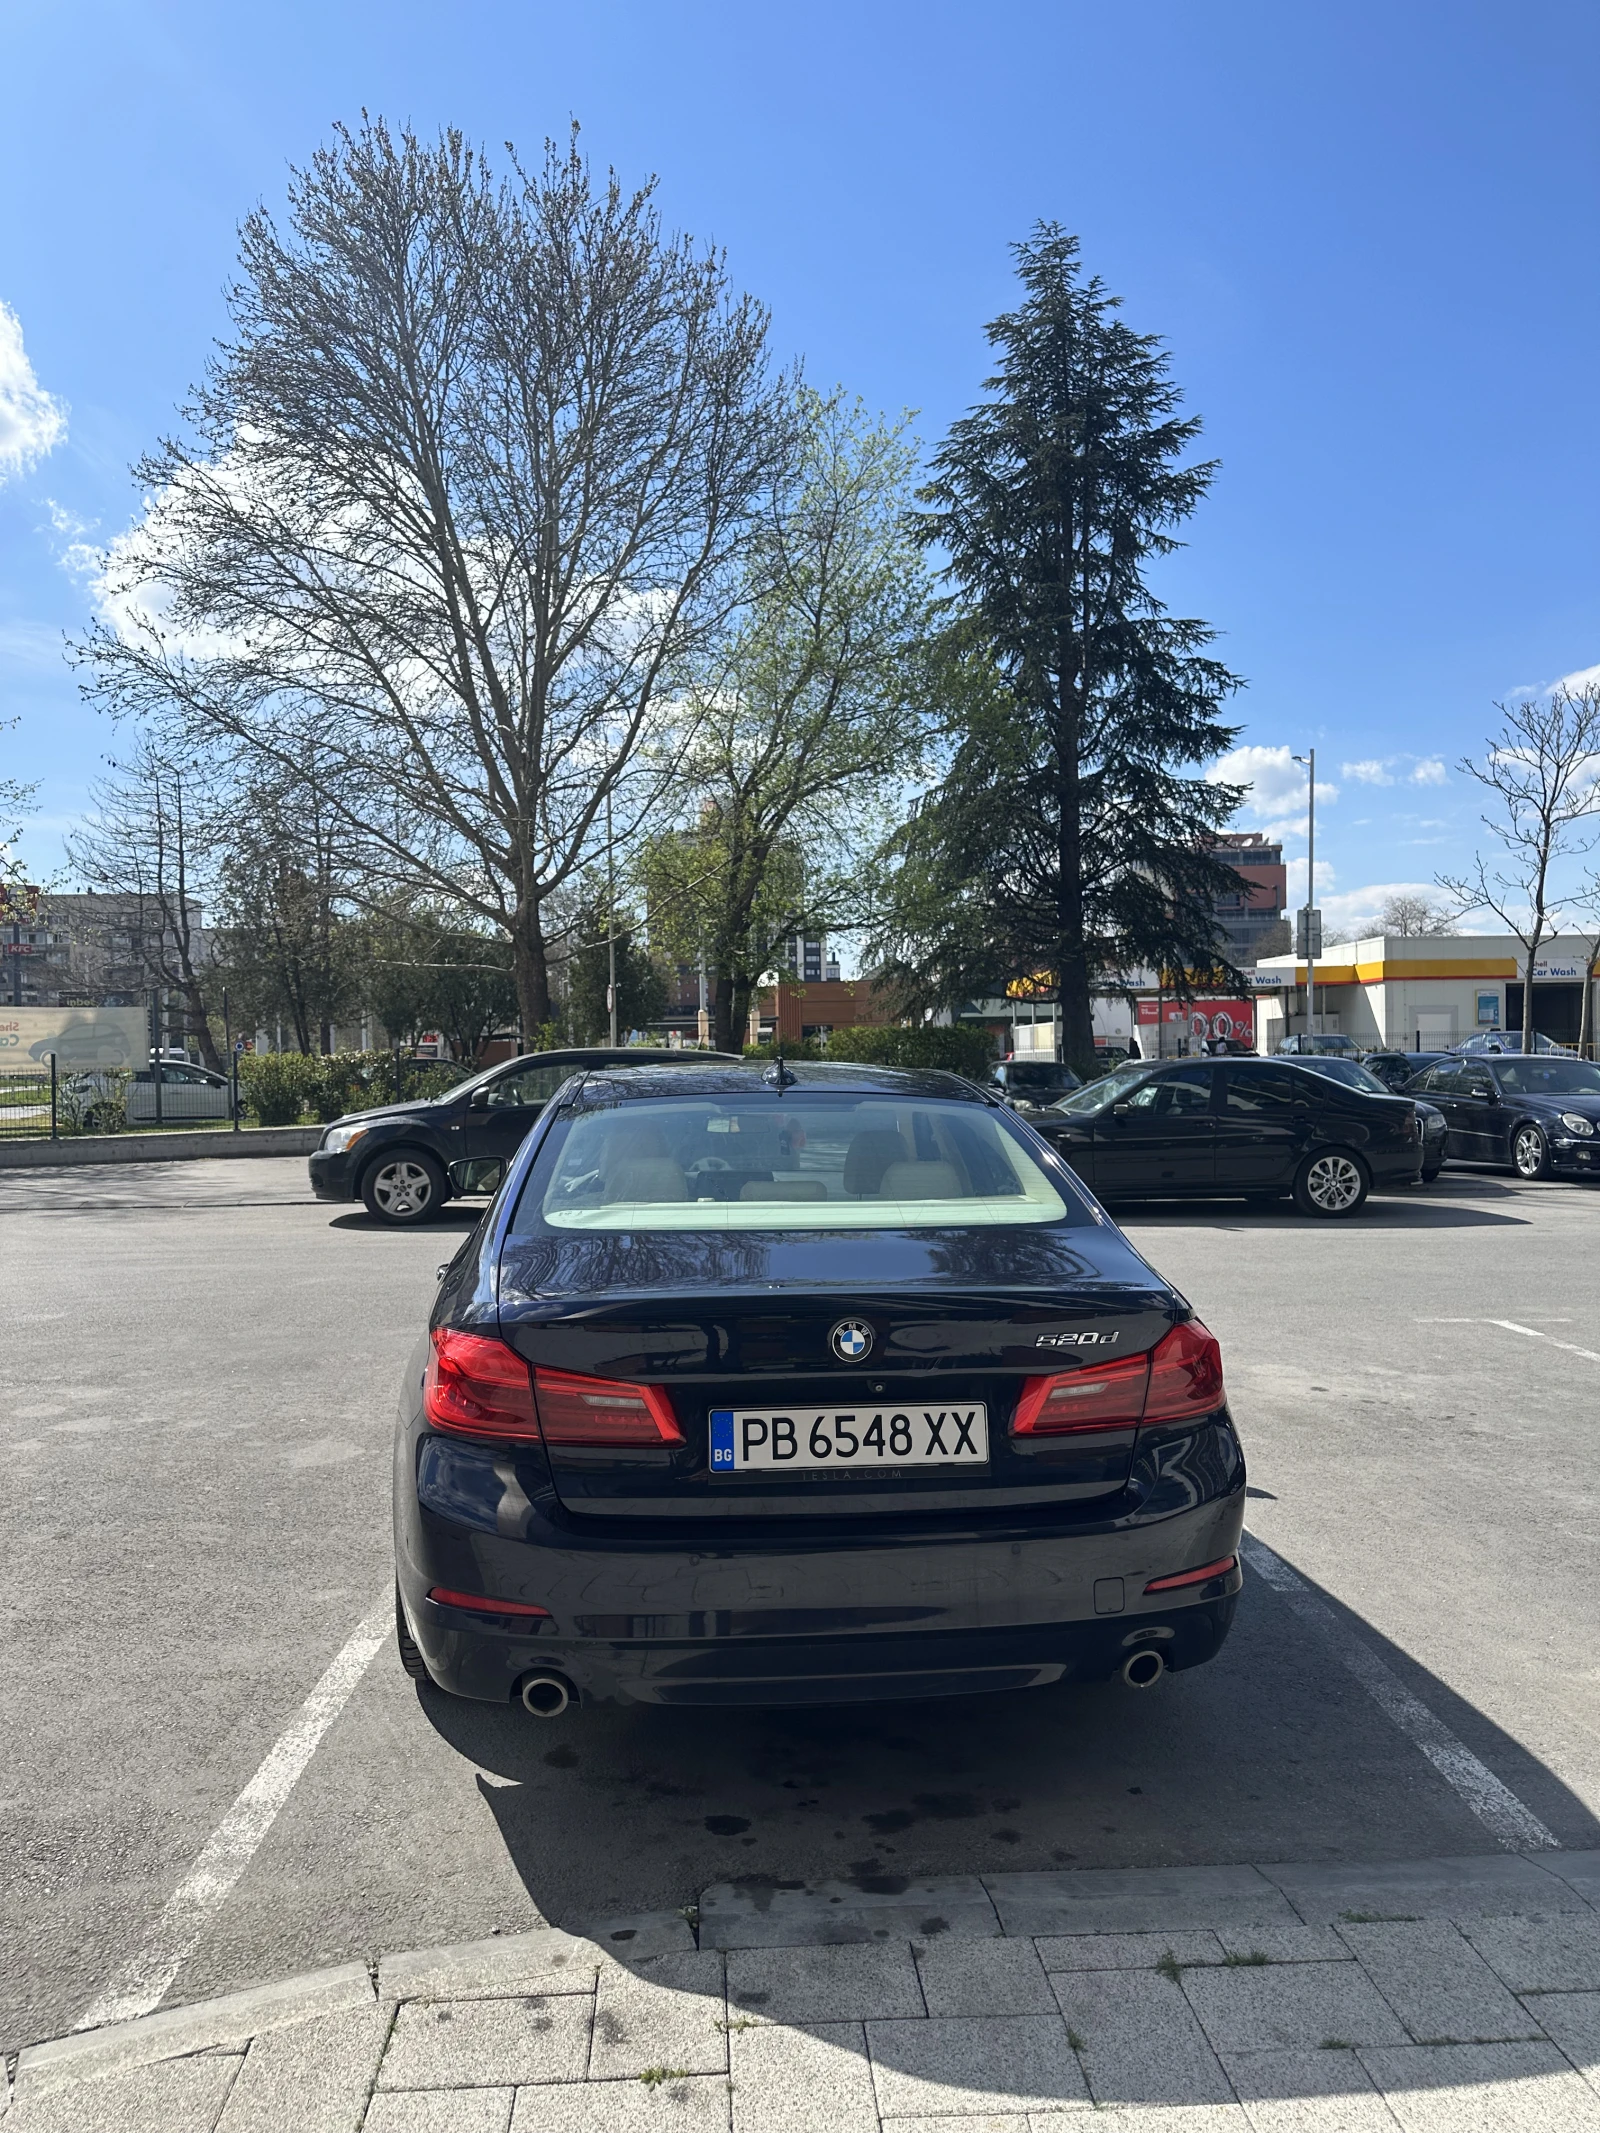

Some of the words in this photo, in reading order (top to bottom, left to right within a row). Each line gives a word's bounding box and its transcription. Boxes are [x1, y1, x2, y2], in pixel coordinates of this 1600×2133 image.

[10, 945, 31, 954] KFC
[1550, 966, 1577, 976] Wash
[1255, 975, 1282, 984] Wash
[836, 1322, 870, 1337] BMW
[1035, 1331, 1120, 1347] 520d
[742, 1418, 798, 1462] PB
[809, 1413, 913, 1459] 6548
[923, 1411, 979, 1456] XX
[714, 1448, 733, 1462] BG
